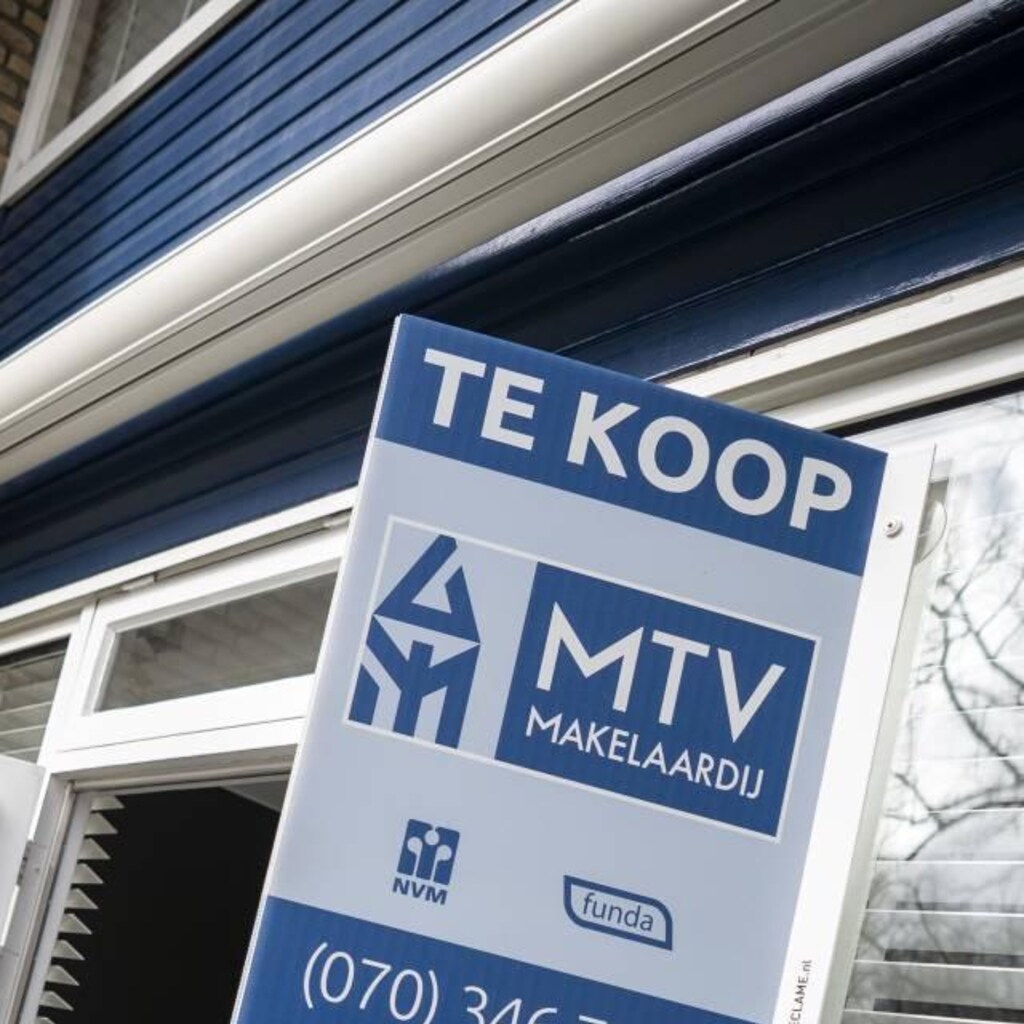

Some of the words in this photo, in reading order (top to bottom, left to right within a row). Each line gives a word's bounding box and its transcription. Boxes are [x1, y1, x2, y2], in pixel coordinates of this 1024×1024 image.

[423, 348, 545, 451] TE
[566, 391, 853, 531] KOOP
[536, 601, 786, 743] MTV
[525, 706, 764, 799] MAKELAARDIJ
[392, 877, 448, 906] NVM
[582, 892, 655, 932] funda
